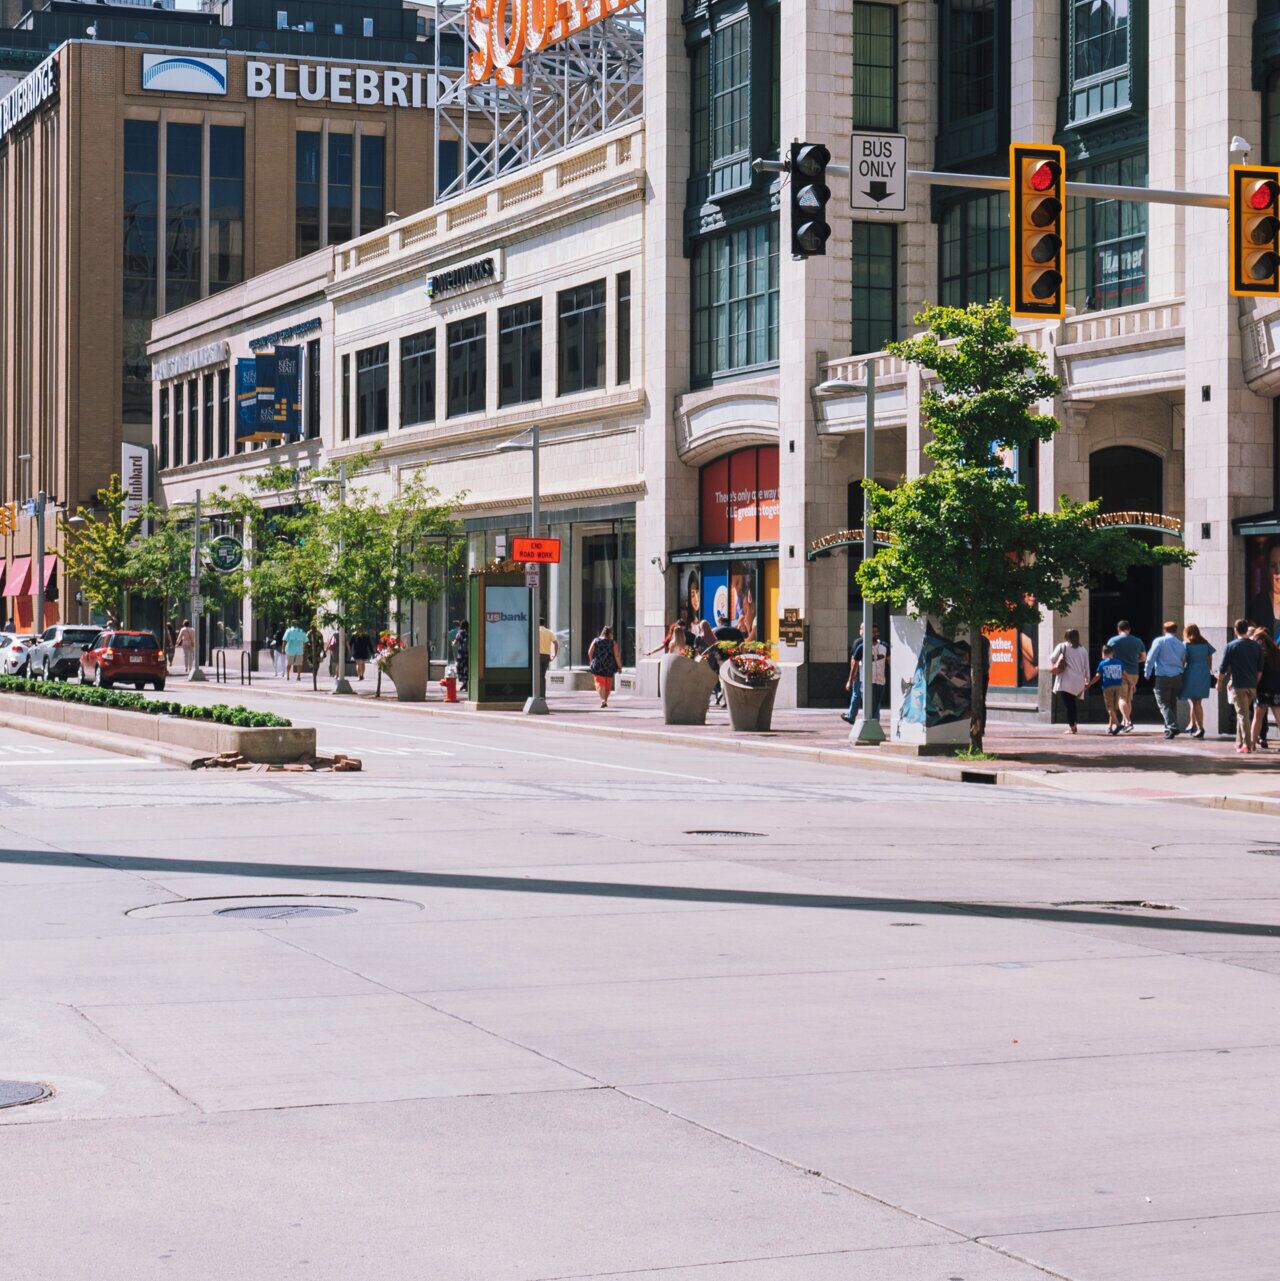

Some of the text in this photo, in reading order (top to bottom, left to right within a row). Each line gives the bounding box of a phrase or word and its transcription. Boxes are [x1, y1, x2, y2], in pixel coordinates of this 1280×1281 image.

[2, 56, 54, 135] BLUEBRIDGE
[862, 140, 893, 158] BUS
[859, 160, 897, 178] ONLY
[128, 455, 143, 501] Hubbard
[737, 488, 751, 504] only
[751, 490, 763, 500] oe
[763, 488, 777, 502] way
